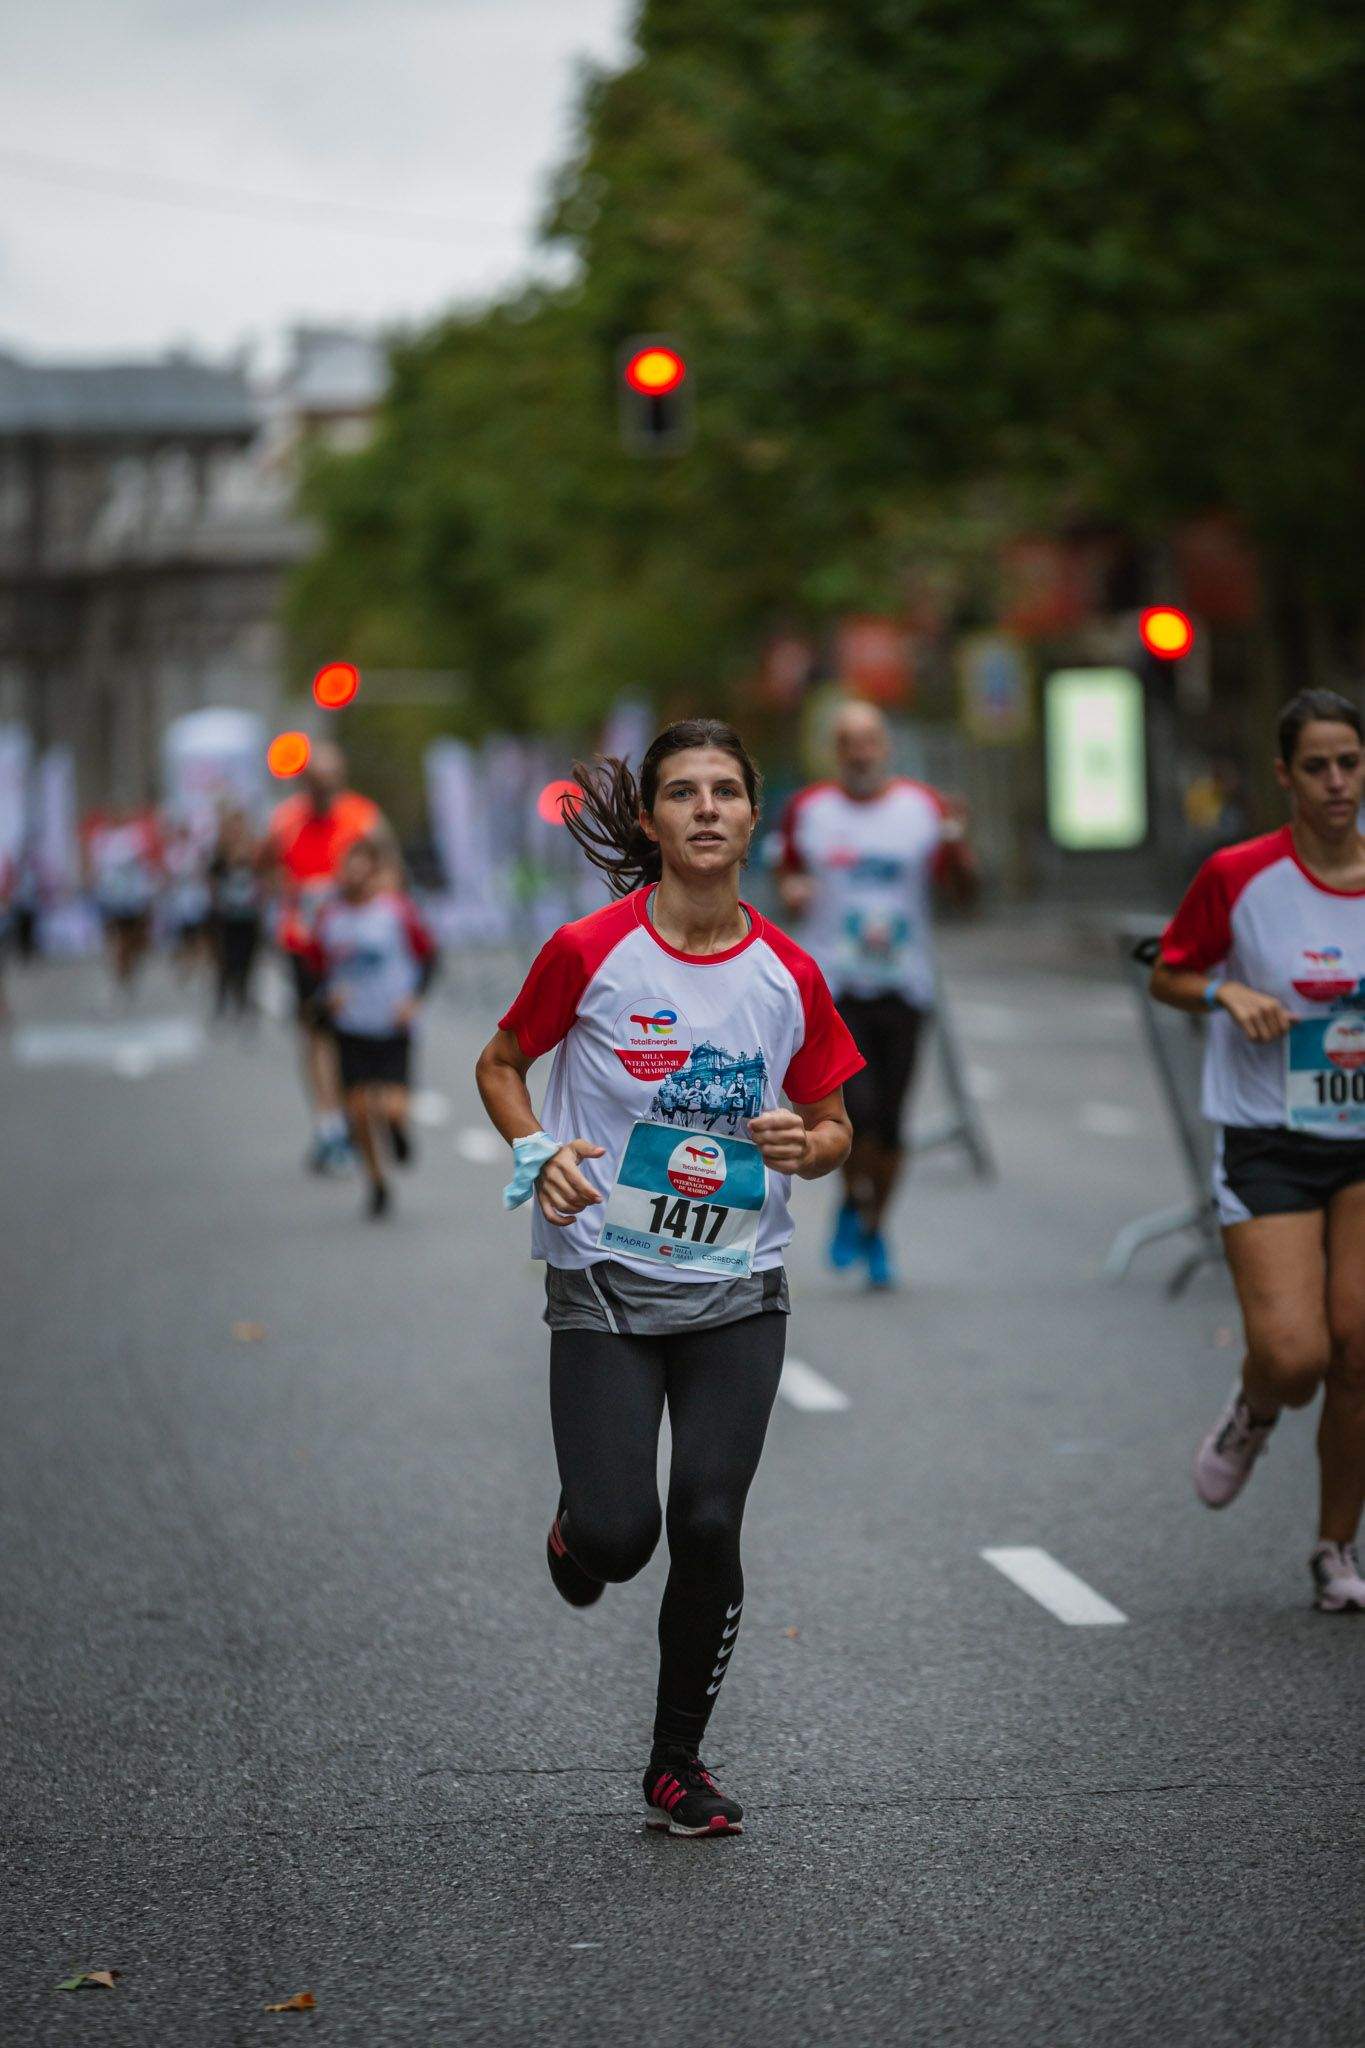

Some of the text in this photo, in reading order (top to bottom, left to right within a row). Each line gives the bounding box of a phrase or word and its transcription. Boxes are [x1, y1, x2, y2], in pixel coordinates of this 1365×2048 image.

[630, 1038, 678, 1046] TotalEnergies
[624, 1059, 680, 1067] INTERNACIONAL
[682, 1163, 717, 1175] TotalEnergies
[687, 1176, 705, 1184] MILLA
[650, 1195, 729, 1244] 1417
[616, 1235, 651, 1250] MADRID
